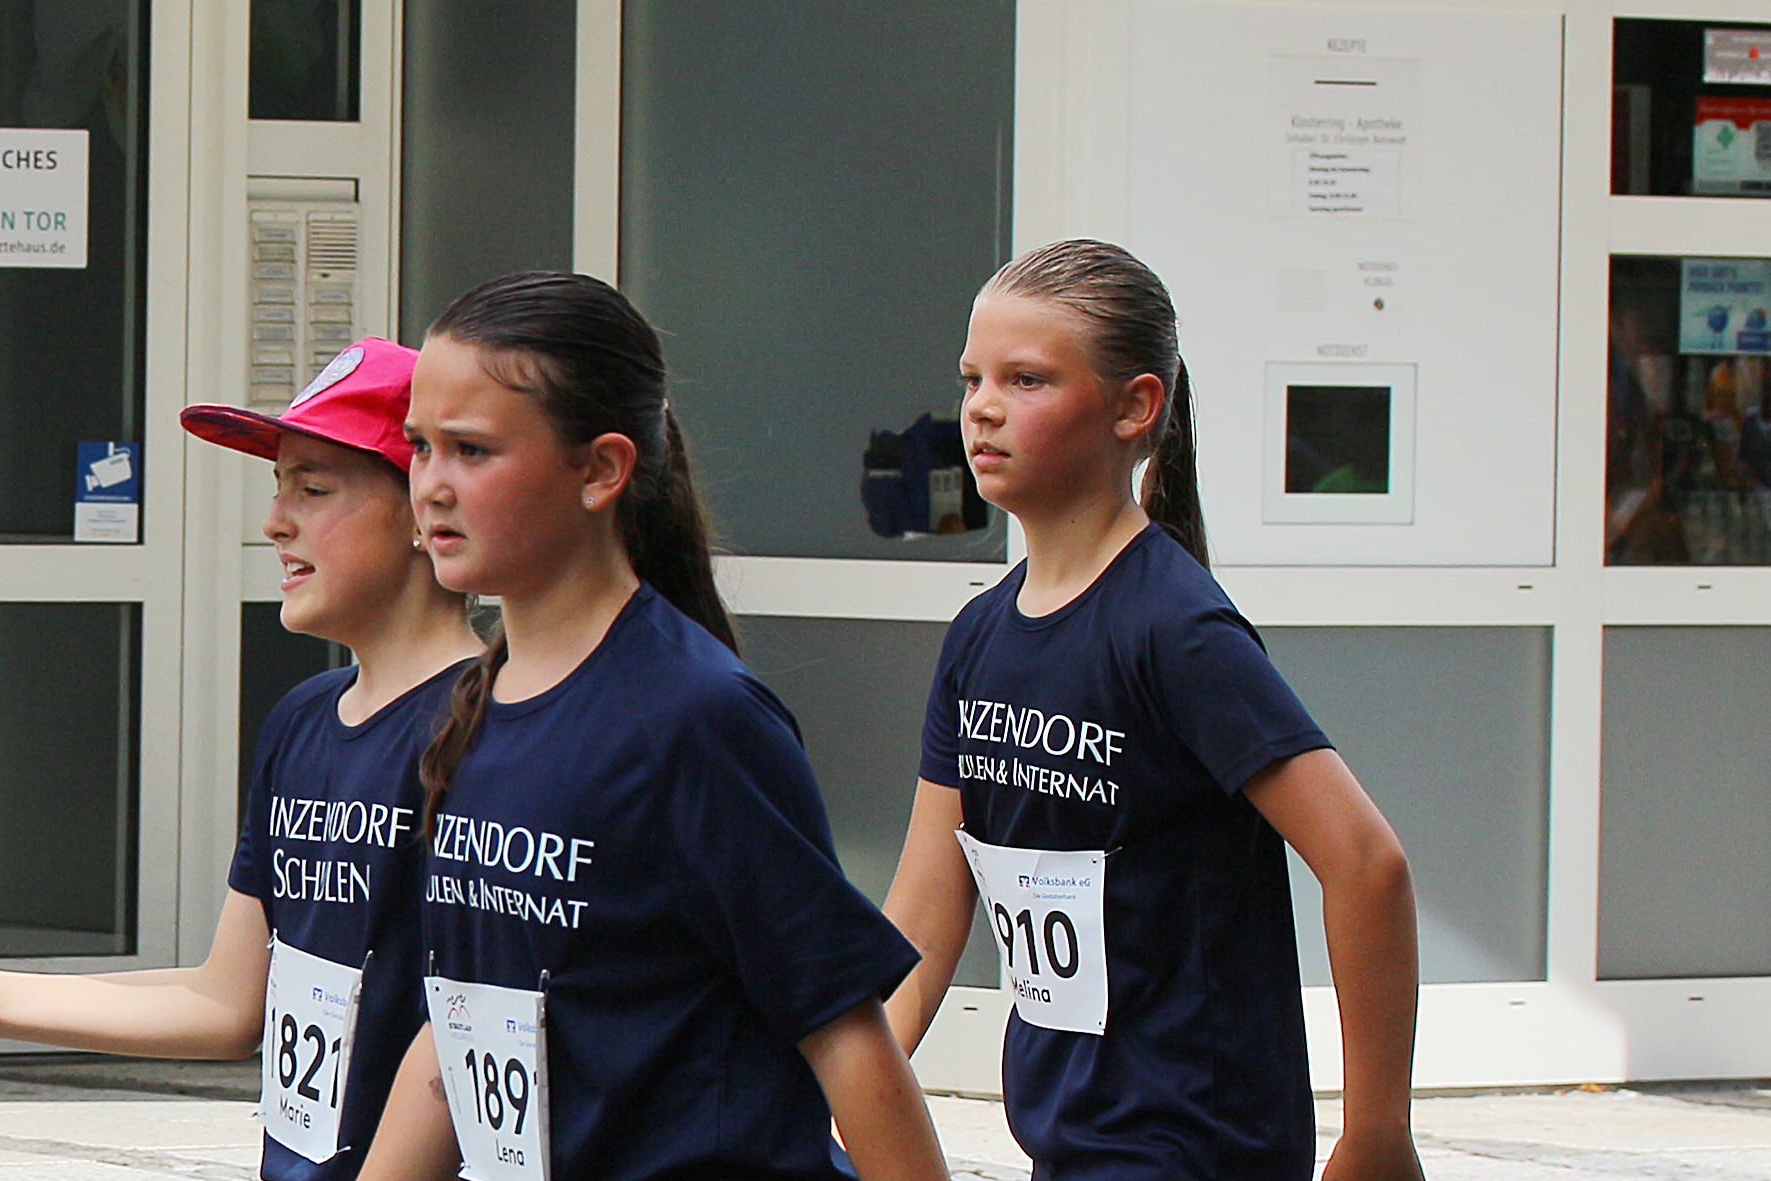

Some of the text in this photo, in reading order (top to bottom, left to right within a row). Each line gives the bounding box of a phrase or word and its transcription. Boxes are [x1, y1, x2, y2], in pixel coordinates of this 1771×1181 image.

[23, 211, 67, 231] TOR
[1013, 757, 1119, 806] INTERNAT
[1031, 876, 1091, 887] Volksbank eG
[988, 897, 1079, 979] 910
[465, 1048, 537, 1135] 189
[279, 1093, 312, 1130] Marie
[495, 1138, 526, 1167] Lena
